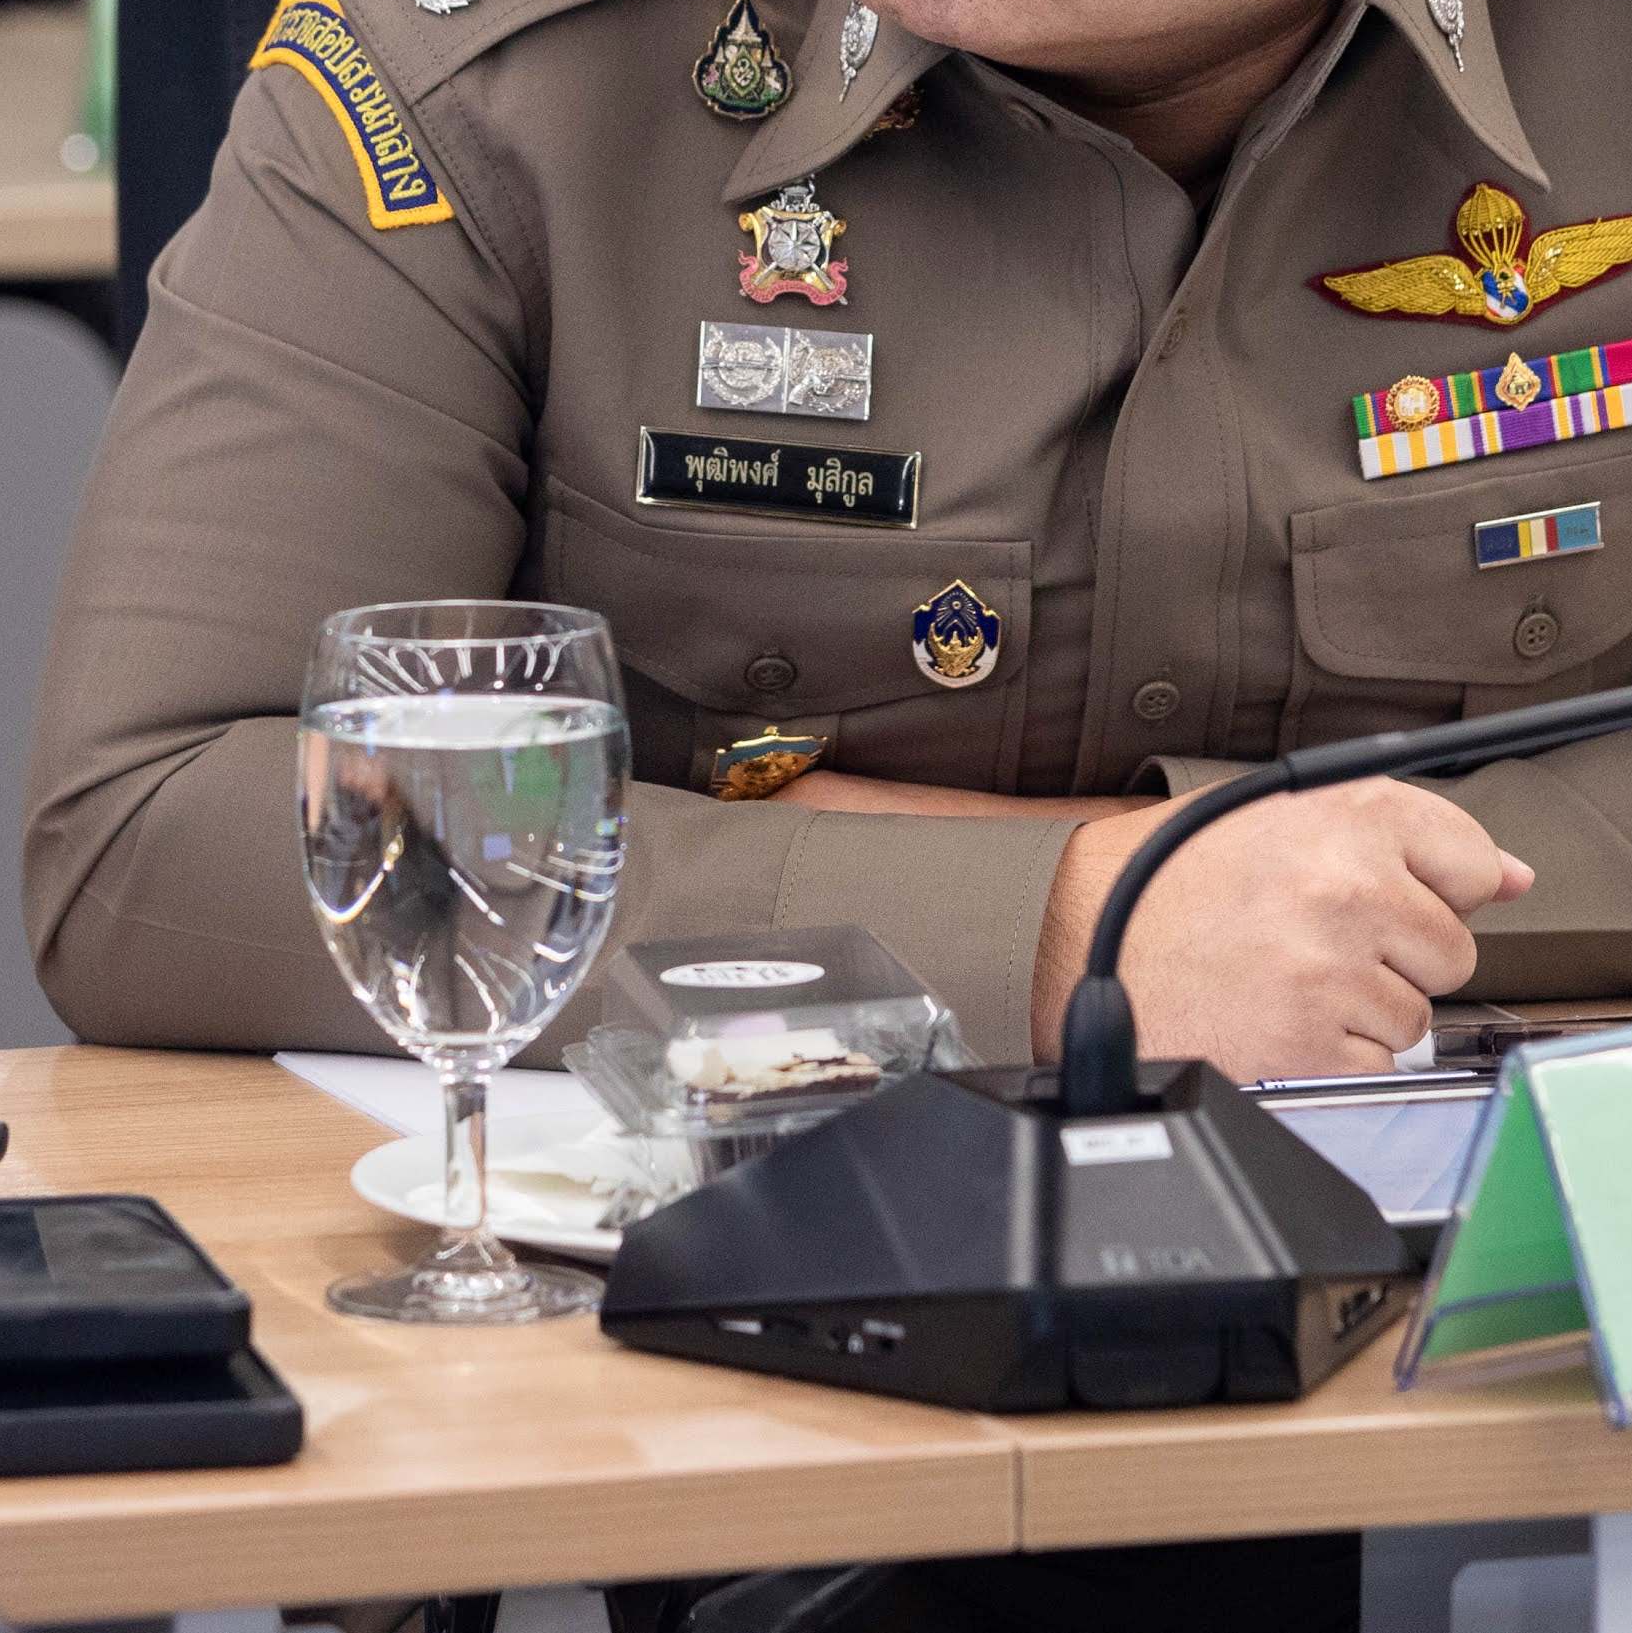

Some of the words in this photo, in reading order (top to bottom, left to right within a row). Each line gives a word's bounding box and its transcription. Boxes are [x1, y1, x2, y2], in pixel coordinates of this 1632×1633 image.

[685, 446, 781, 493] พุฒิพงศ์
[807, 458, 874, 507] มุสิกูล
